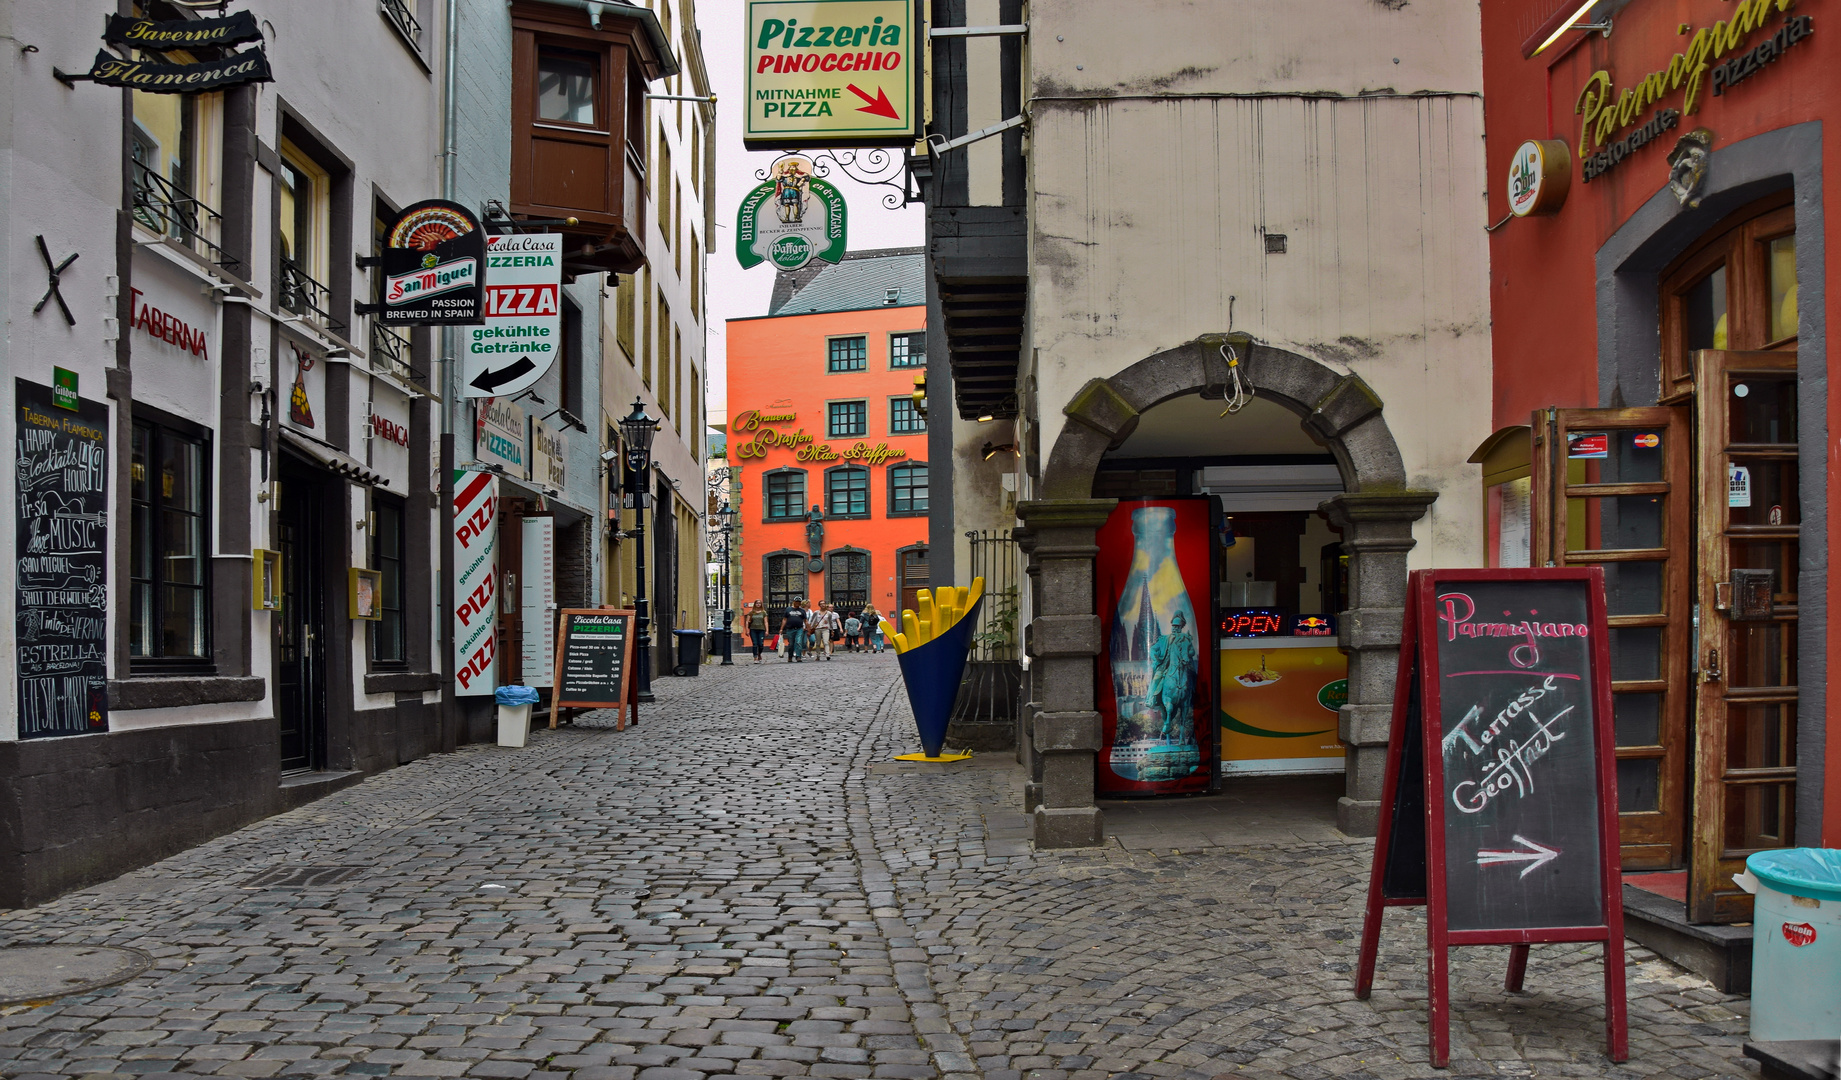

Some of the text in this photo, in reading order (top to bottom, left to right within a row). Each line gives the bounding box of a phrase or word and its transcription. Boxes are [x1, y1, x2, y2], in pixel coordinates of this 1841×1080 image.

[125, 20, 236, 41] Taverna
[757, 16, 901, 50] Pizzeria
[756, 51, 901, 74] PINOCCHIO
[1711, 14, 1812, 97] Pizzeria
[94, 58, 258, 85] Flamenca
[756, 88, 841, 101] MITNAHME
[763, 101, 833, 118] PIZZA
[1582, 107, 1680, 184] Ristorante
[1513, 170, 1536, 198] Dom
[741, 186, 775, 241] BIERHAUS
[829, 197, 842, 239] SALZGASS
[522, 237, 555, 251] Casa
[772, 242, 810, 255] Päffgen
[486, 255, 554, 268] IZZERIA
[386, 309, 474, 319] BREWED IN SPAIN
[431, 298, 475, 308] PASSION
[485, 287, 557, 315] IZZA
[130, 286, 208, 361] TABERNA
[472, 325, 551, 341] gekühlte
[470, 341, 552, 354] Getränke
[22, 406, 104, 442] TABERNA FLAMENCA
[372, 413, 410, 449] AMENCA
[505, 407, 522, 437] Casa
[732, 410, 797, 432] Brauerei
[25, 428, 57, 452] HAPPY
[479, 426, 522, 467] PIZZERIA
[537, 426, 556, 463] Black
[736, 427, 813, 458] Pfaffen
[796, 441, 906, 465] Max Päffgen
[29, 438, 78, 478] Cocktails
[64, 468, 89, 493] HOUR
[548, 457, 565, 487] Pearl
[50, 518, 96, 550] MUSIC
[22, 556, 70, 574] SAN MIGUEL
[459, 554, 486, 586] gekühlte
[21, 590, 44, 607] SHOT
[47, 590, 69, 606] DER
[68, 590, 91, 606] WOCHE
[38, 609, 61, 631] Tinto
[59, 624, 74, 634] DE
[573, 615, 622, 625] Piccola Casa
[573, 625, 621, 633] PIZZERIA
[1222, 615, 1281, 633] OPEN
[1437, 592, 1589, 668] Parmigiano
[20, 643, 100, 664] ESTRELLA
[459, 624, 487, 656] gekühlte
[22, 675, 90, 733] FIESTA PARTY
[1441, 674, 1558, 756] Terrasse
[1452, 704, 1575, 814] Geöffnet
